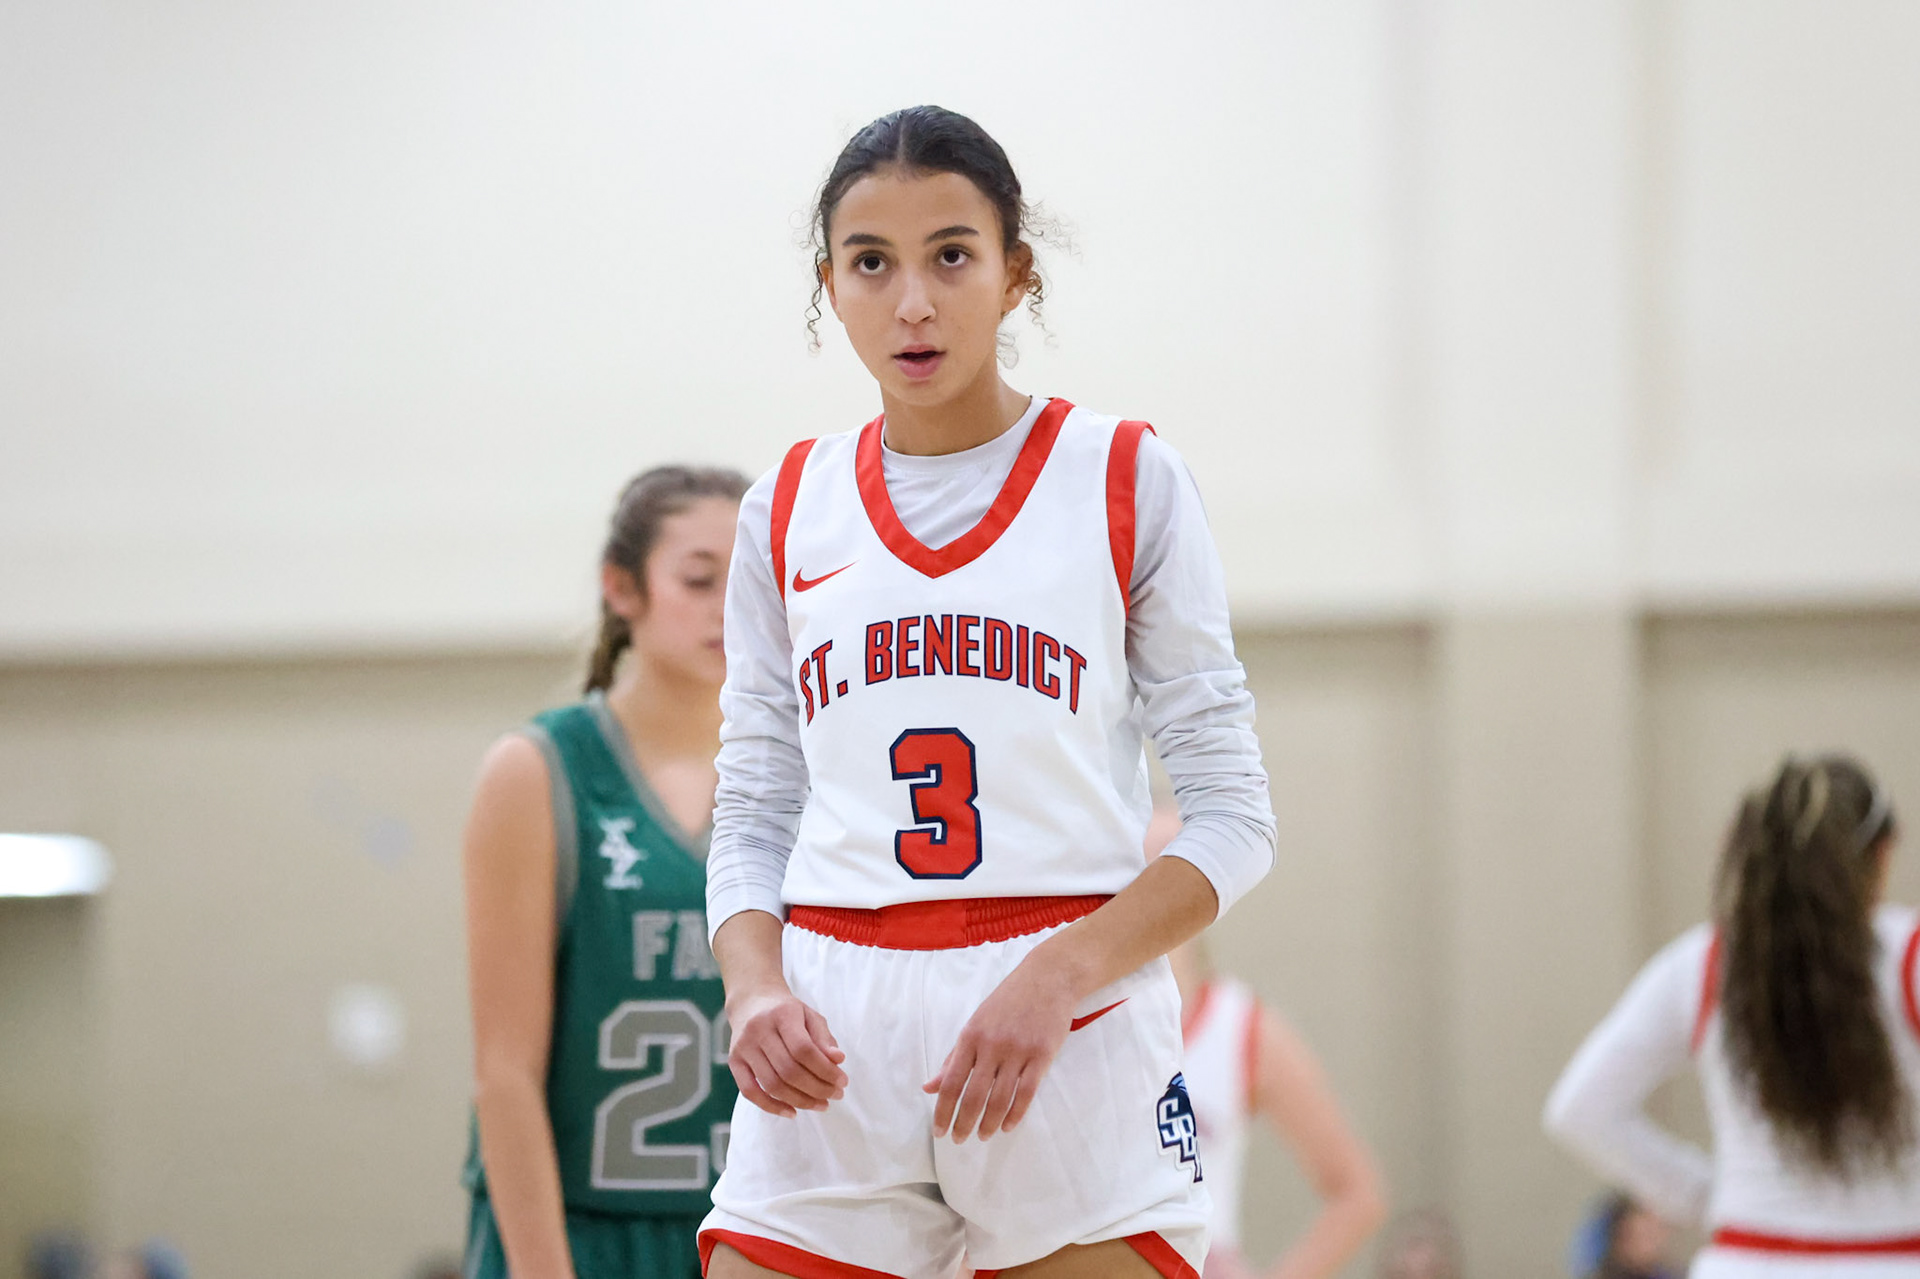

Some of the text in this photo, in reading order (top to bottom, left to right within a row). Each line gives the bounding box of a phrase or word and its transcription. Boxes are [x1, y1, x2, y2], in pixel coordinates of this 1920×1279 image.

[799, 614, 1087, 727] ST. BENEDICT
[889, 727, 983, 880] 3
